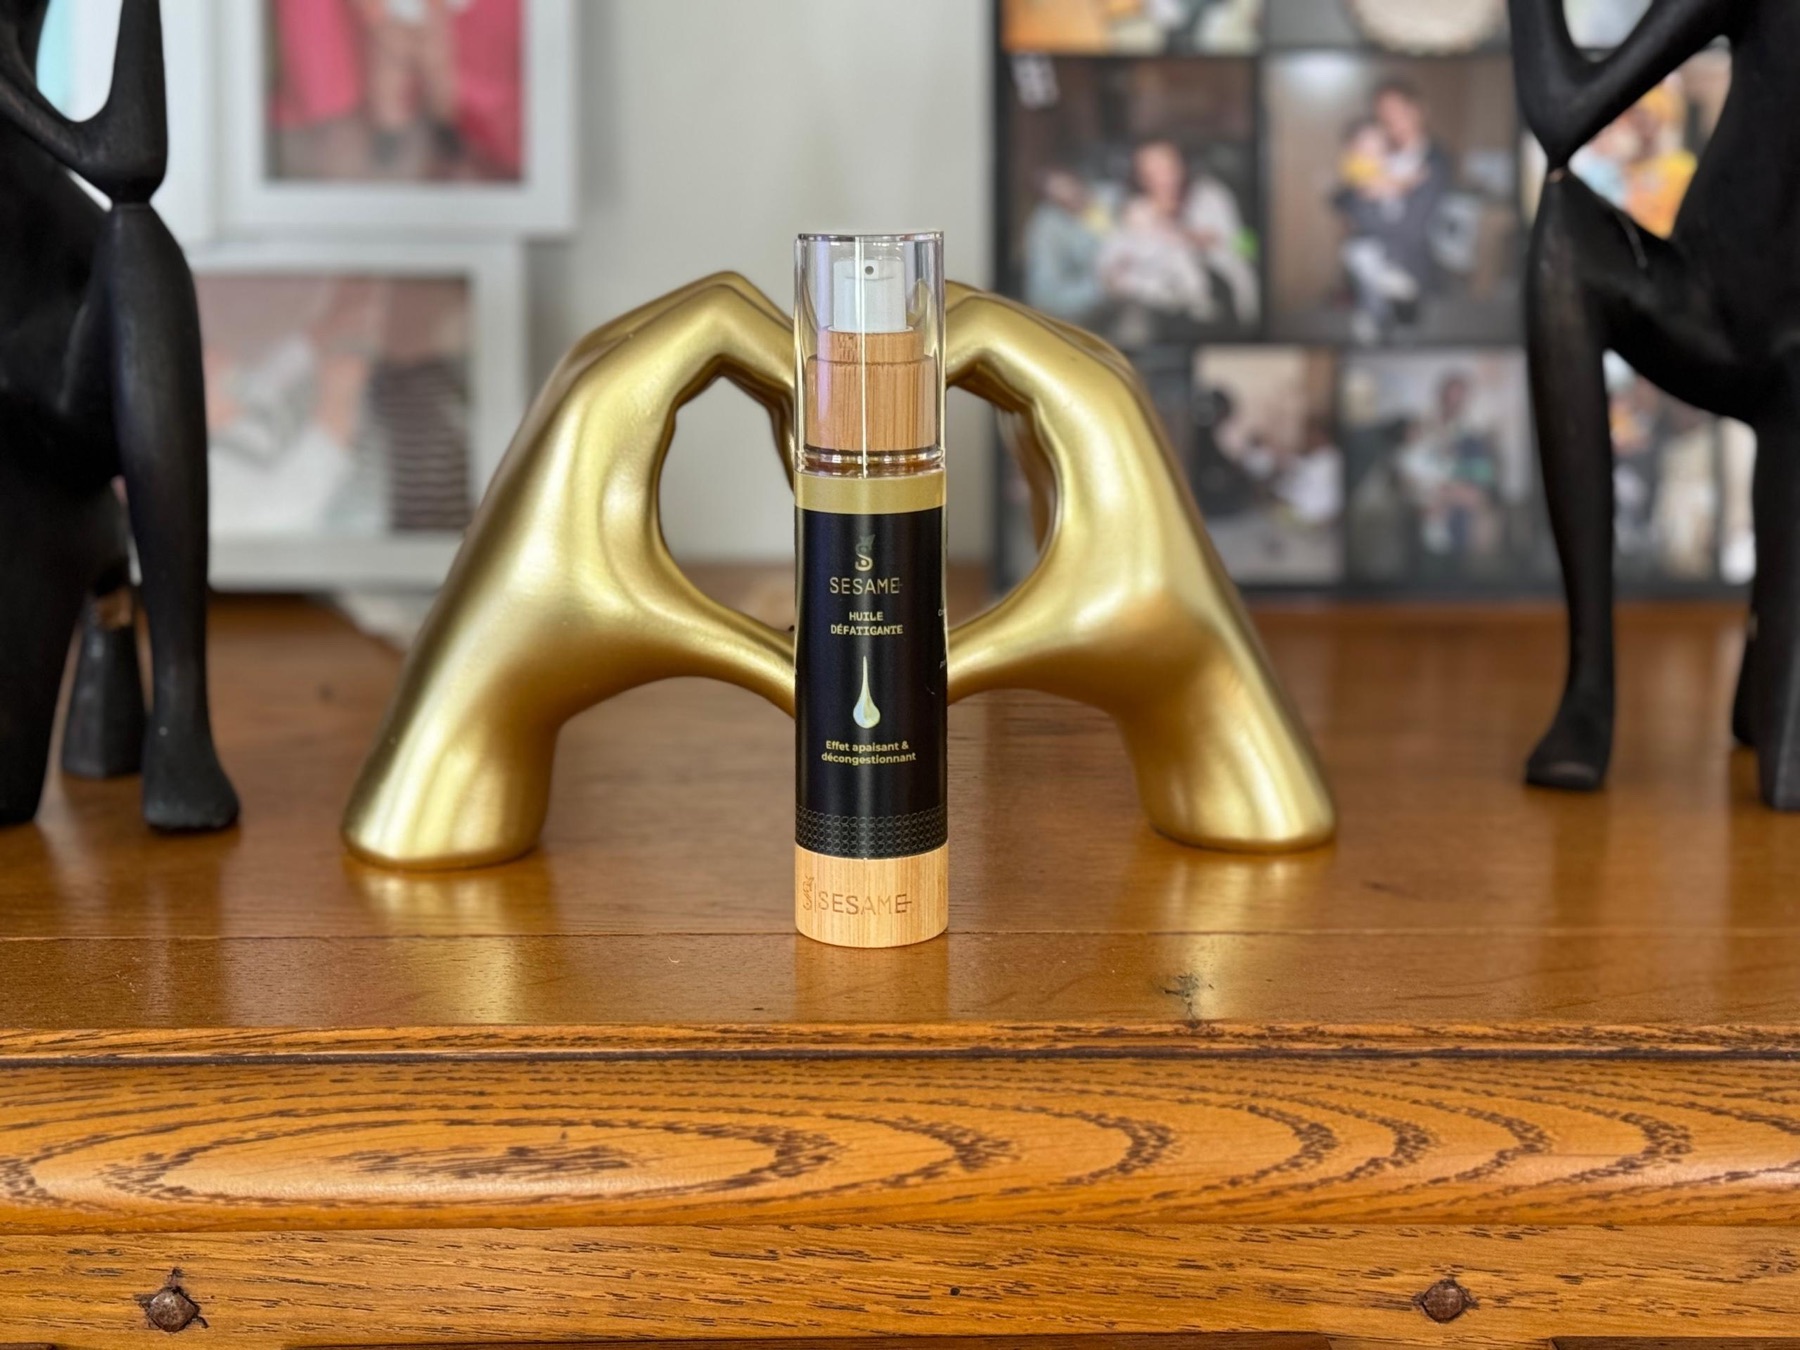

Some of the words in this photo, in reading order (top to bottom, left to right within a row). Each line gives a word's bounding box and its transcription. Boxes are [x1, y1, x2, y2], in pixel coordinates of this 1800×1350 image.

[829, 576, 903, 595] SESAME
[849, 611, 884, 622] HUILE
[830, 623, 904, 636] DÉFATIGANTE
[825, 740, 850, 752] Effet
[852, 741, 899, 753] apaisant
[901, 740, 909, 750] &
[821, 752, 917, 766] décongestionnant
[818, 891, 912, 915] SESAME
